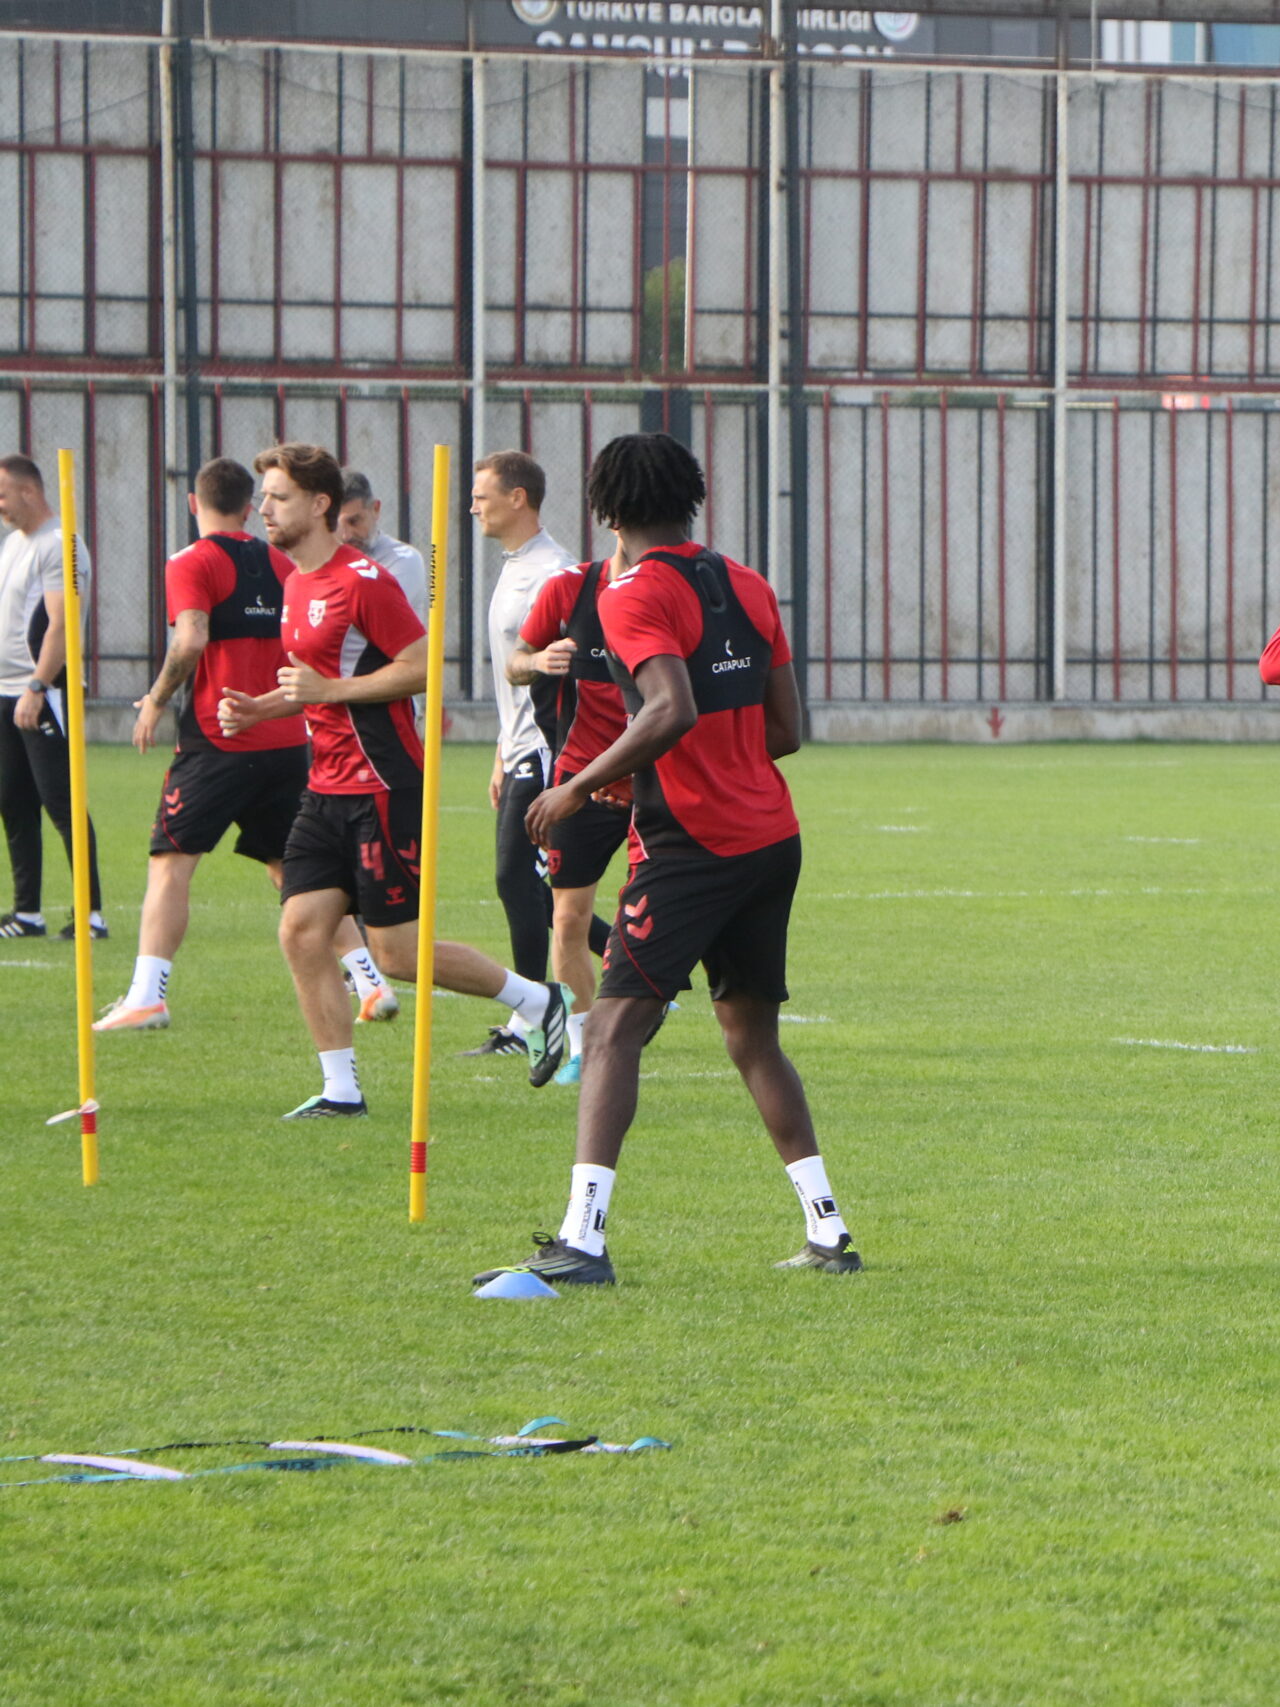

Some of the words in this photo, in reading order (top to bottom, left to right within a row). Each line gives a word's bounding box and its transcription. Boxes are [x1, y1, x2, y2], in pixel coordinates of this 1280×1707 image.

[244, 606, 277, 616] CATAPULT
[711, 656, 751, 674] CATAPULT
[360, 842, 385, 880] 4
